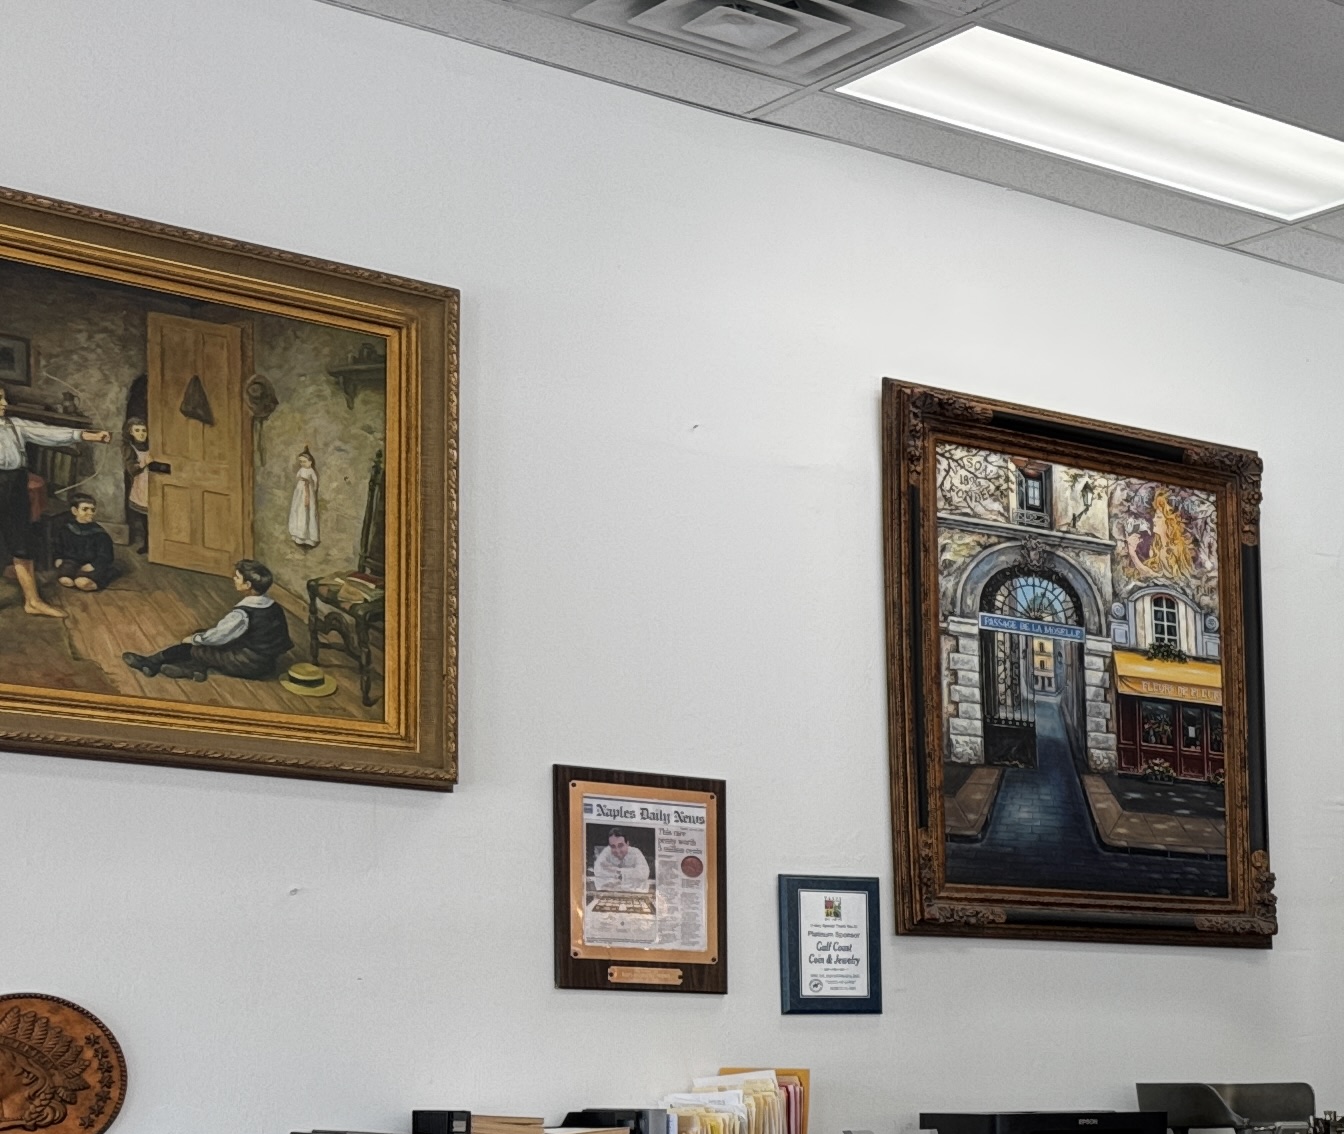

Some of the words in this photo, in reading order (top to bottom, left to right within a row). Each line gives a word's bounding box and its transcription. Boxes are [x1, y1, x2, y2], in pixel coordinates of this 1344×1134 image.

[596, 803, 636, 820] Naples
[639, 807, 671, 825] Daily
[673, 810, 706, 825] News
